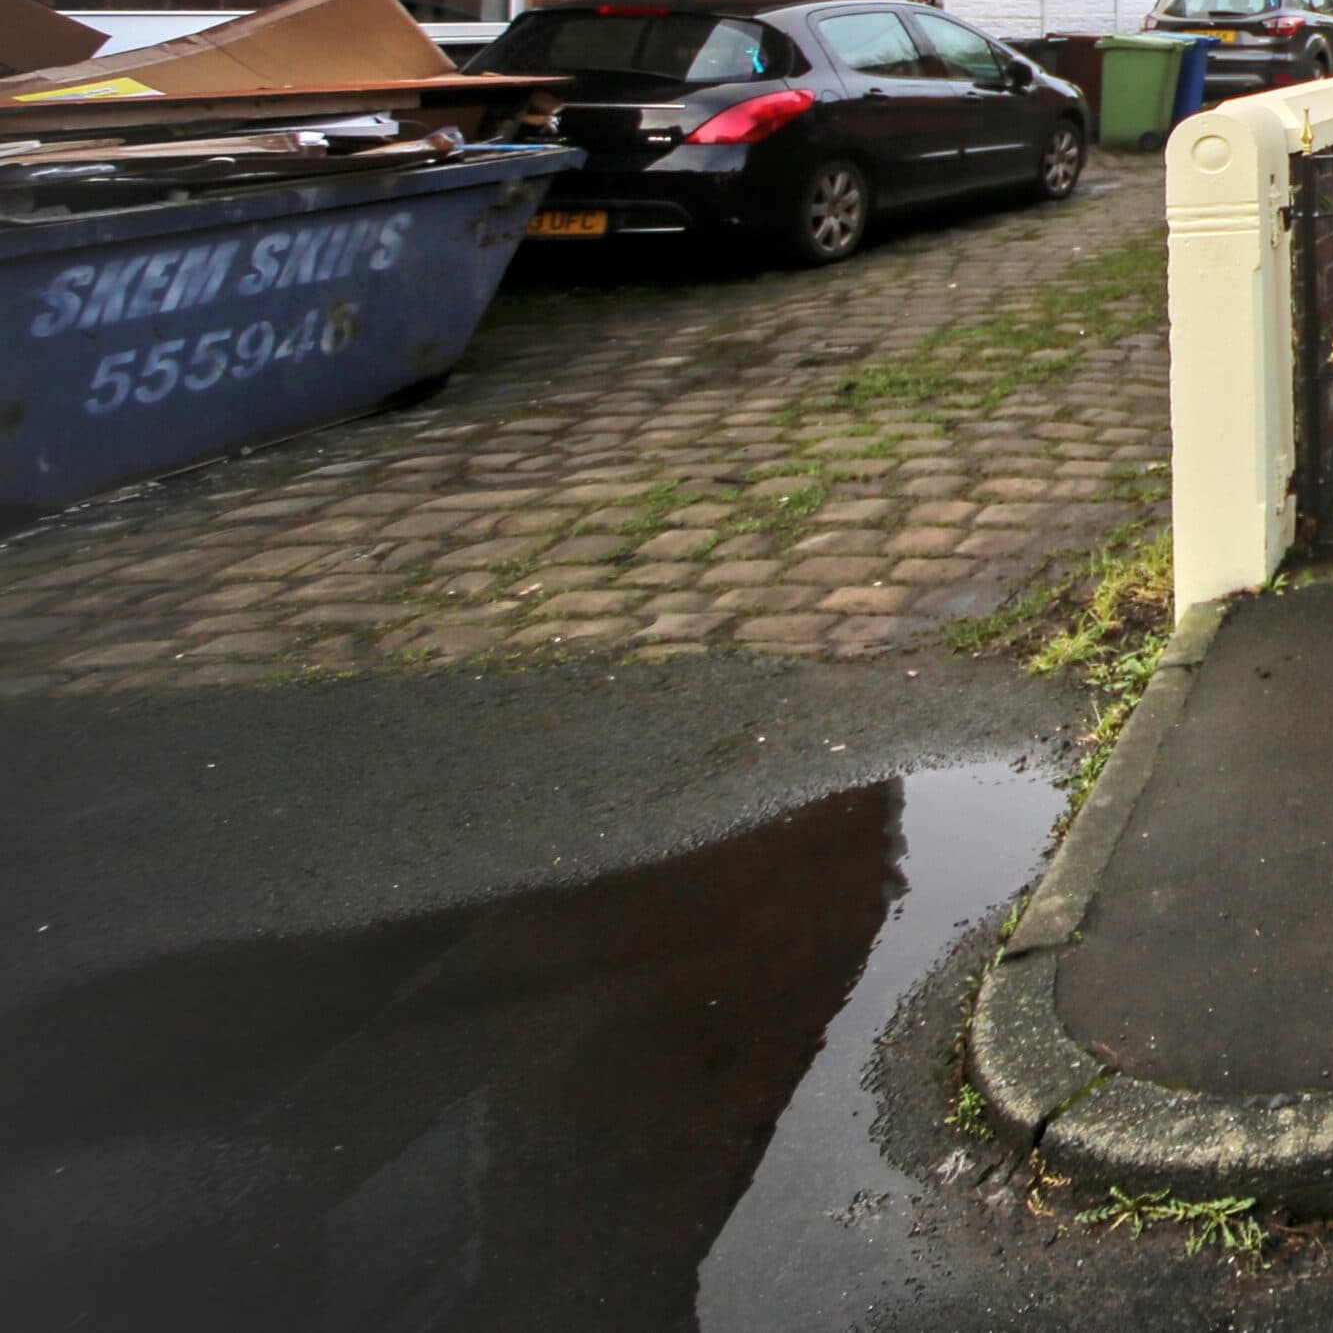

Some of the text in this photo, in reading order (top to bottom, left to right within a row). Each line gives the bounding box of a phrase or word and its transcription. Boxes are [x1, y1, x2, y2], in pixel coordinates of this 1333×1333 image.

[29, 211, 412, 338] SKEM SKIPS
[83, 301, 360, 415] 555946
